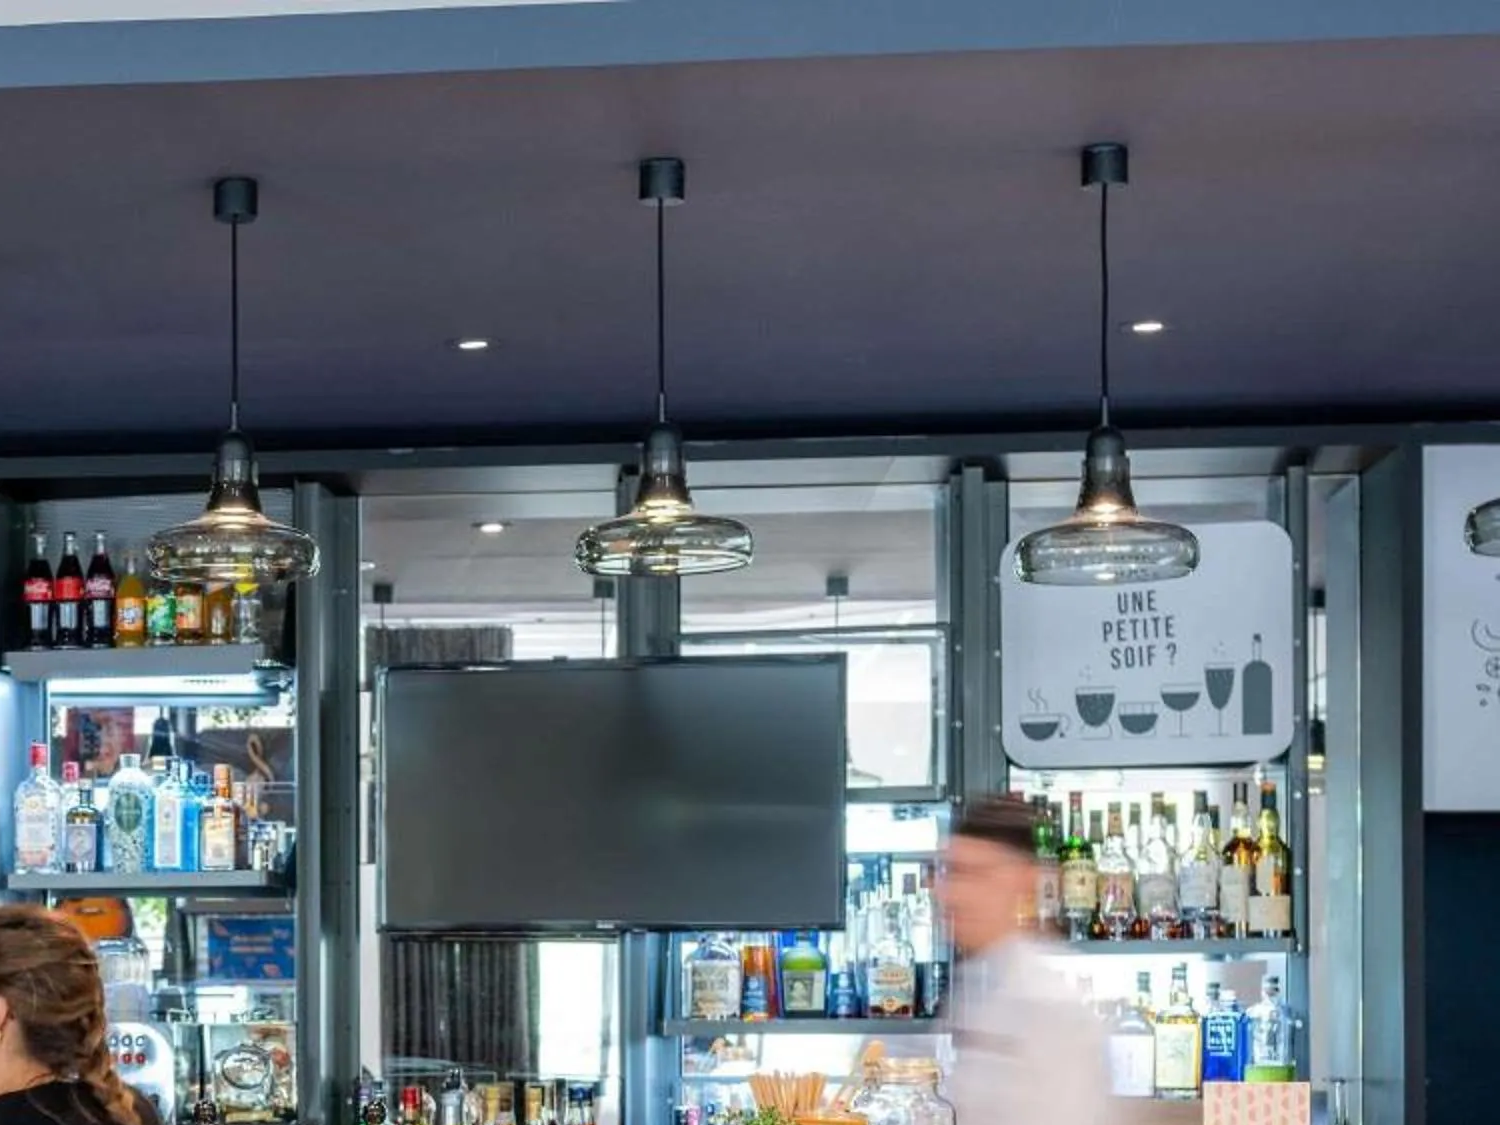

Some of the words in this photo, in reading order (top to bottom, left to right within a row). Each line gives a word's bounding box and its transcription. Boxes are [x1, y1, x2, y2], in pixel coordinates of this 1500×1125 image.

[1117, 589, 1158, 615] UNE
[1102, 615, 1176, 643] PETITE
[1110, 644, 1156, 670] SOIF
[1164, 642, 1177, 667] ?
